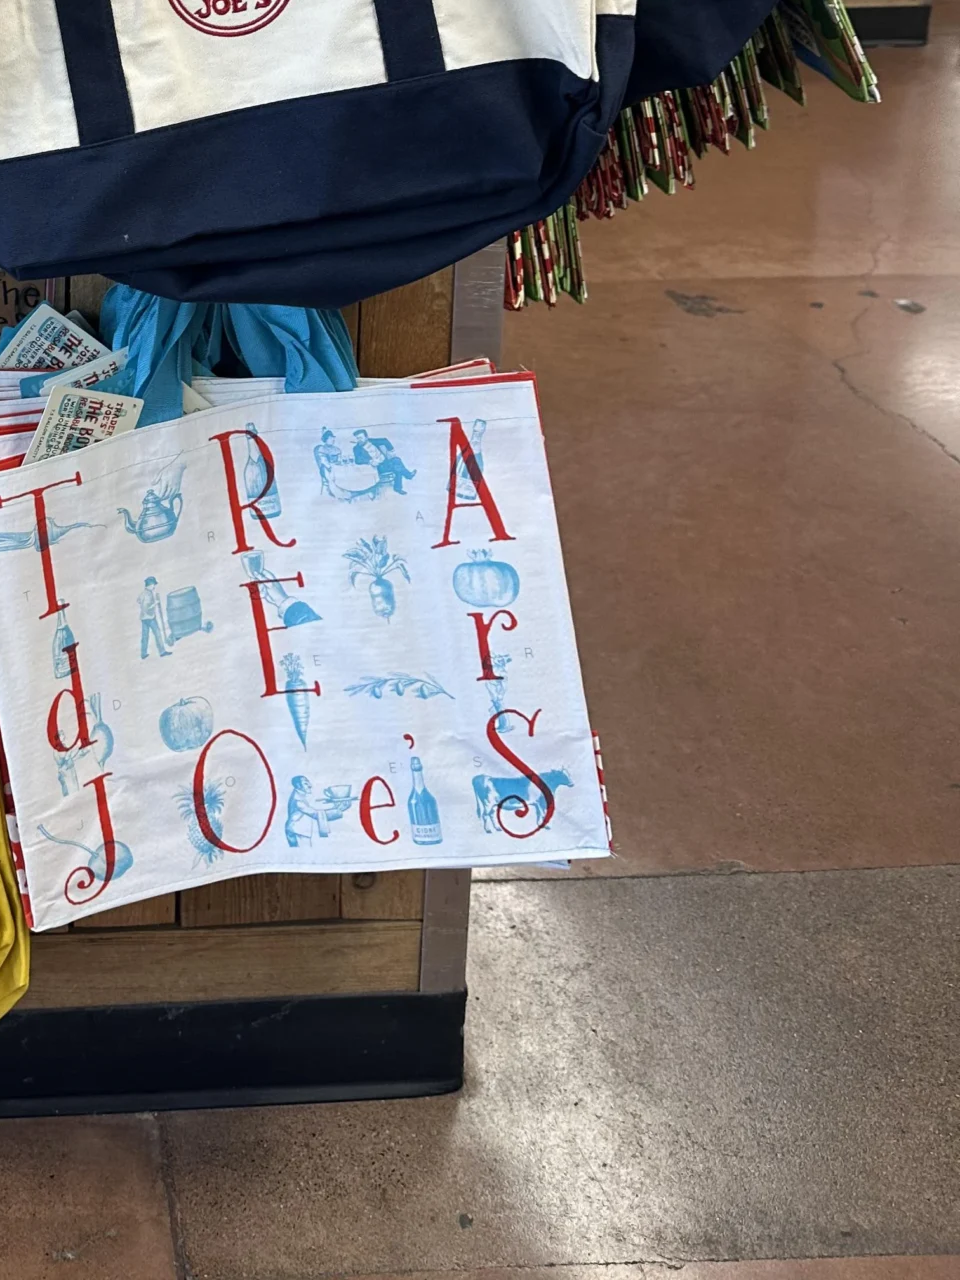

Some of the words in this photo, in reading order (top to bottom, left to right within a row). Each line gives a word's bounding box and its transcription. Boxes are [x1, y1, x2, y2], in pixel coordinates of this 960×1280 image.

[58, 333, 84, 359] THE
[62, 398, 72, 412] FOR
[66, 400, 77, 418] WITH
[83, 399, 105, 425] THE
[104, 401, 124, 437] TRADER
